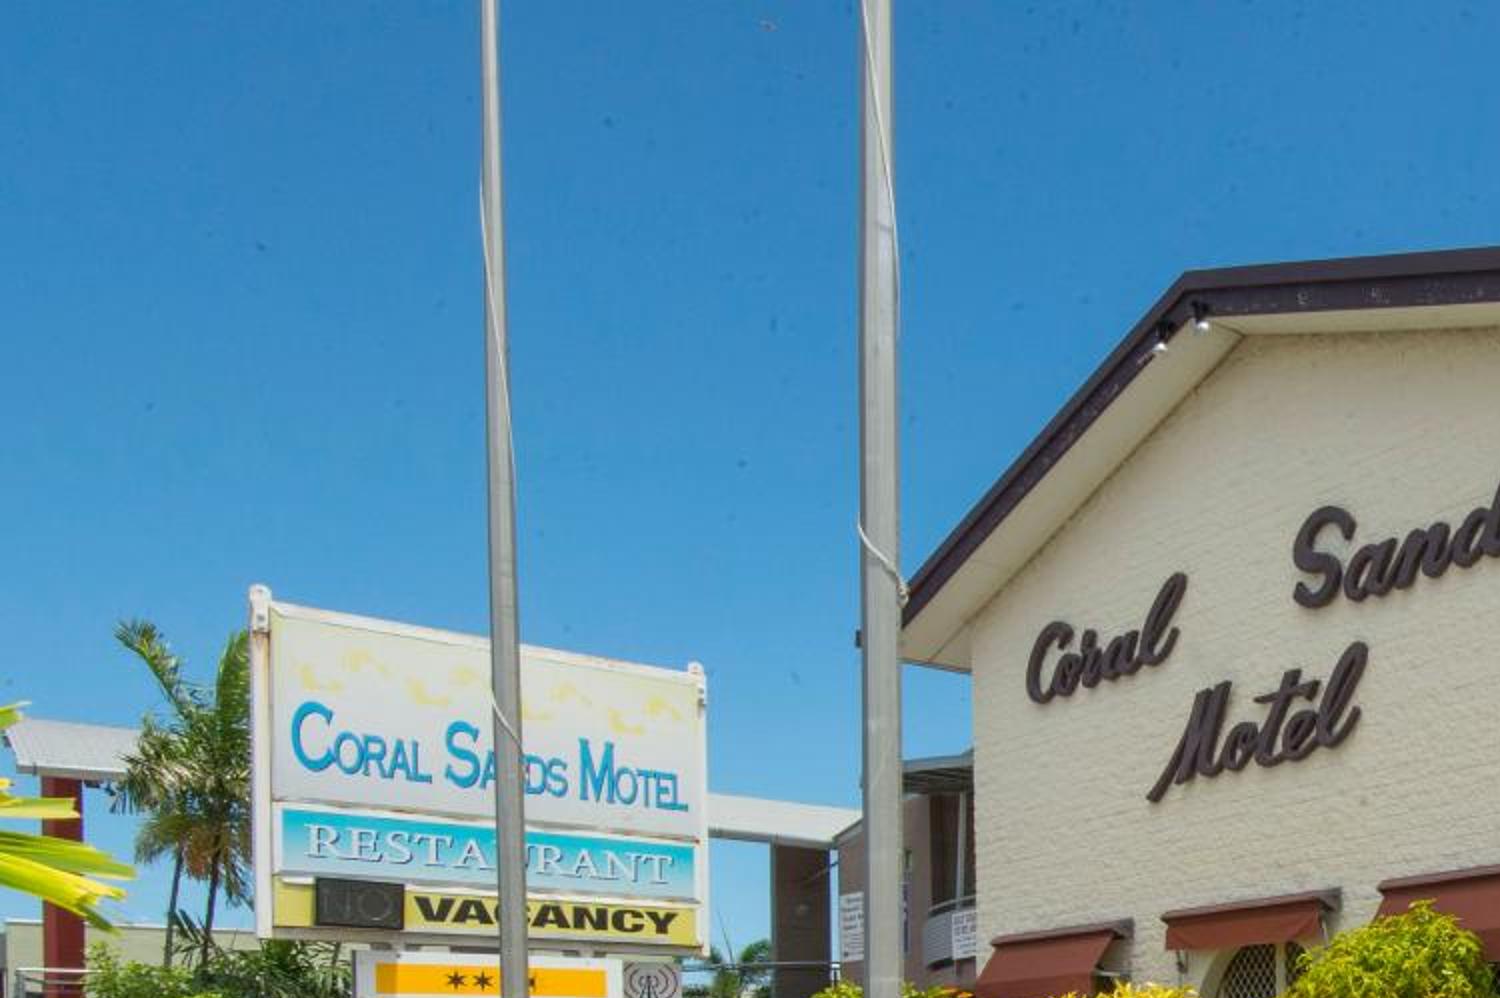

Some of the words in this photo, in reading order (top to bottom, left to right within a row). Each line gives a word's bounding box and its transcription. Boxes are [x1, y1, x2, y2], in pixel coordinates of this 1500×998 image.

[1026, 572, 1188, 705] Coral
[291, 701, 432, 784] CORAL
[445, 720, 568, 798] SADS
[578, 737, 688, 812] MOTEL
[1145, 640, 1369, 803] Motel
[303, 822, 675, 885] RESTARANT
